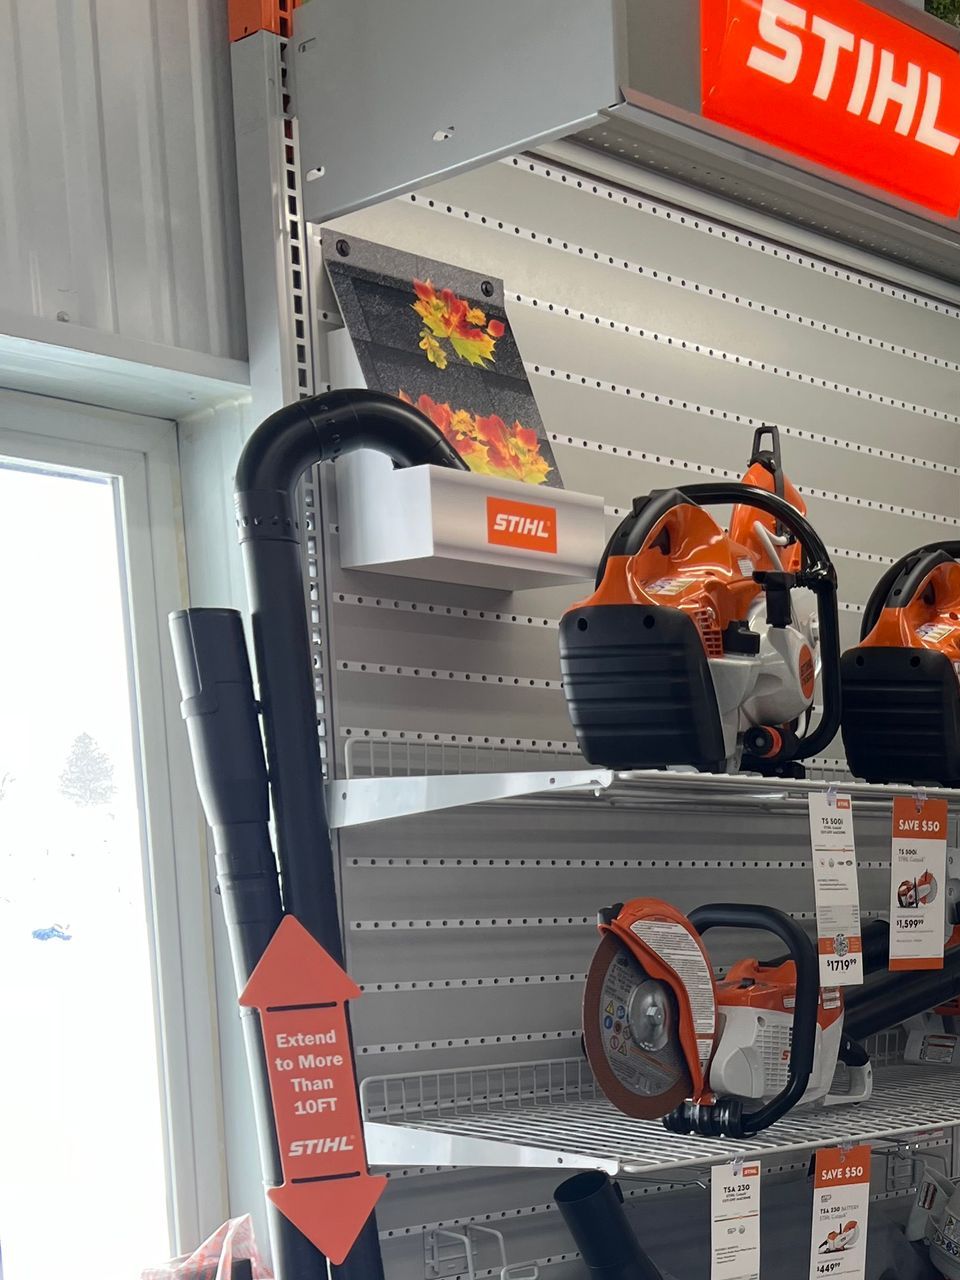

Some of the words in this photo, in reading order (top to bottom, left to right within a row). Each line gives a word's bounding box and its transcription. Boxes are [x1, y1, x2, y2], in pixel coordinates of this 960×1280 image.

[747, 0, 960, 155] STIHL
[494, 514, 549, 538] STIHL
[821, 817, 829, 825] TS
[899, 819, 919, 831] SAVE
[922, 820, 940, 832] $50
[276, 1030, 336, 1049] Extend
[275, 1056, 294, 1072] to
[298, 1054, 343, 1069] More
[290, 1077, 334, 1093] Than
[294, 1098, 338, 1115] 10FT
[288, 1136, 354, 1157] STIHL
[821, 1168, 842, 1180] SAVE
[845, 1166, 863, 1178] $50
[723, 1185, 736, 1193] TSA
[738, 1184, 750, 1192] 230
